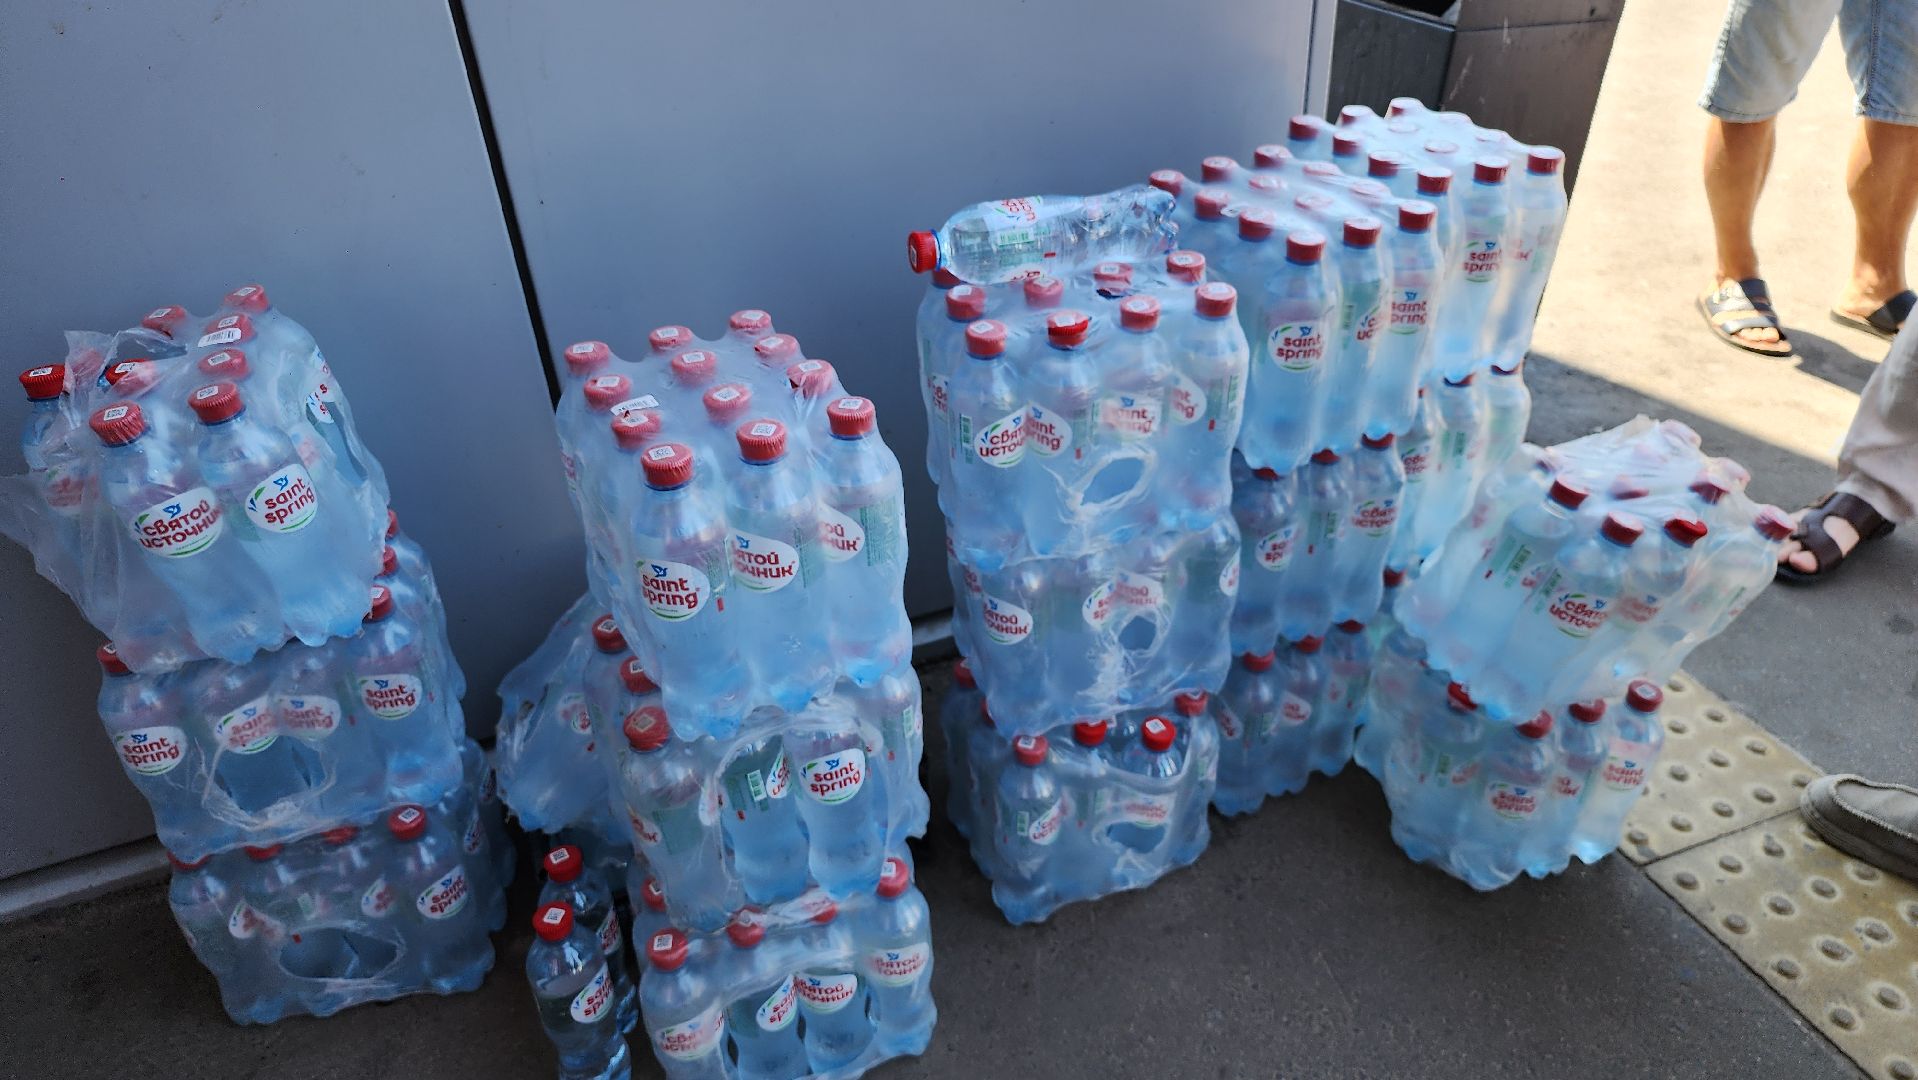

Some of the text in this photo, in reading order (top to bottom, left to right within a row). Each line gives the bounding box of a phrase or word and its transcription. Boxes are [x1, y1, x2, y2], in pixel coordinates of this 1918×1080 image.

[990, 427, 1025, 446] свят
[265, 477, 306, 510] saint
[264, 487, 314, 524] spring
[734, 546, 780, 565] ятой
[735, 561, 794, 579] очник
[642, 573, 689, 592] saint
[984, 603, 1018, 625] ятой
[985, 615, 1028, 635] очник
[230, 708, 273, 735] sain
[813, 761, 856, 782] saint
[810, 770, 861, 796] spring
